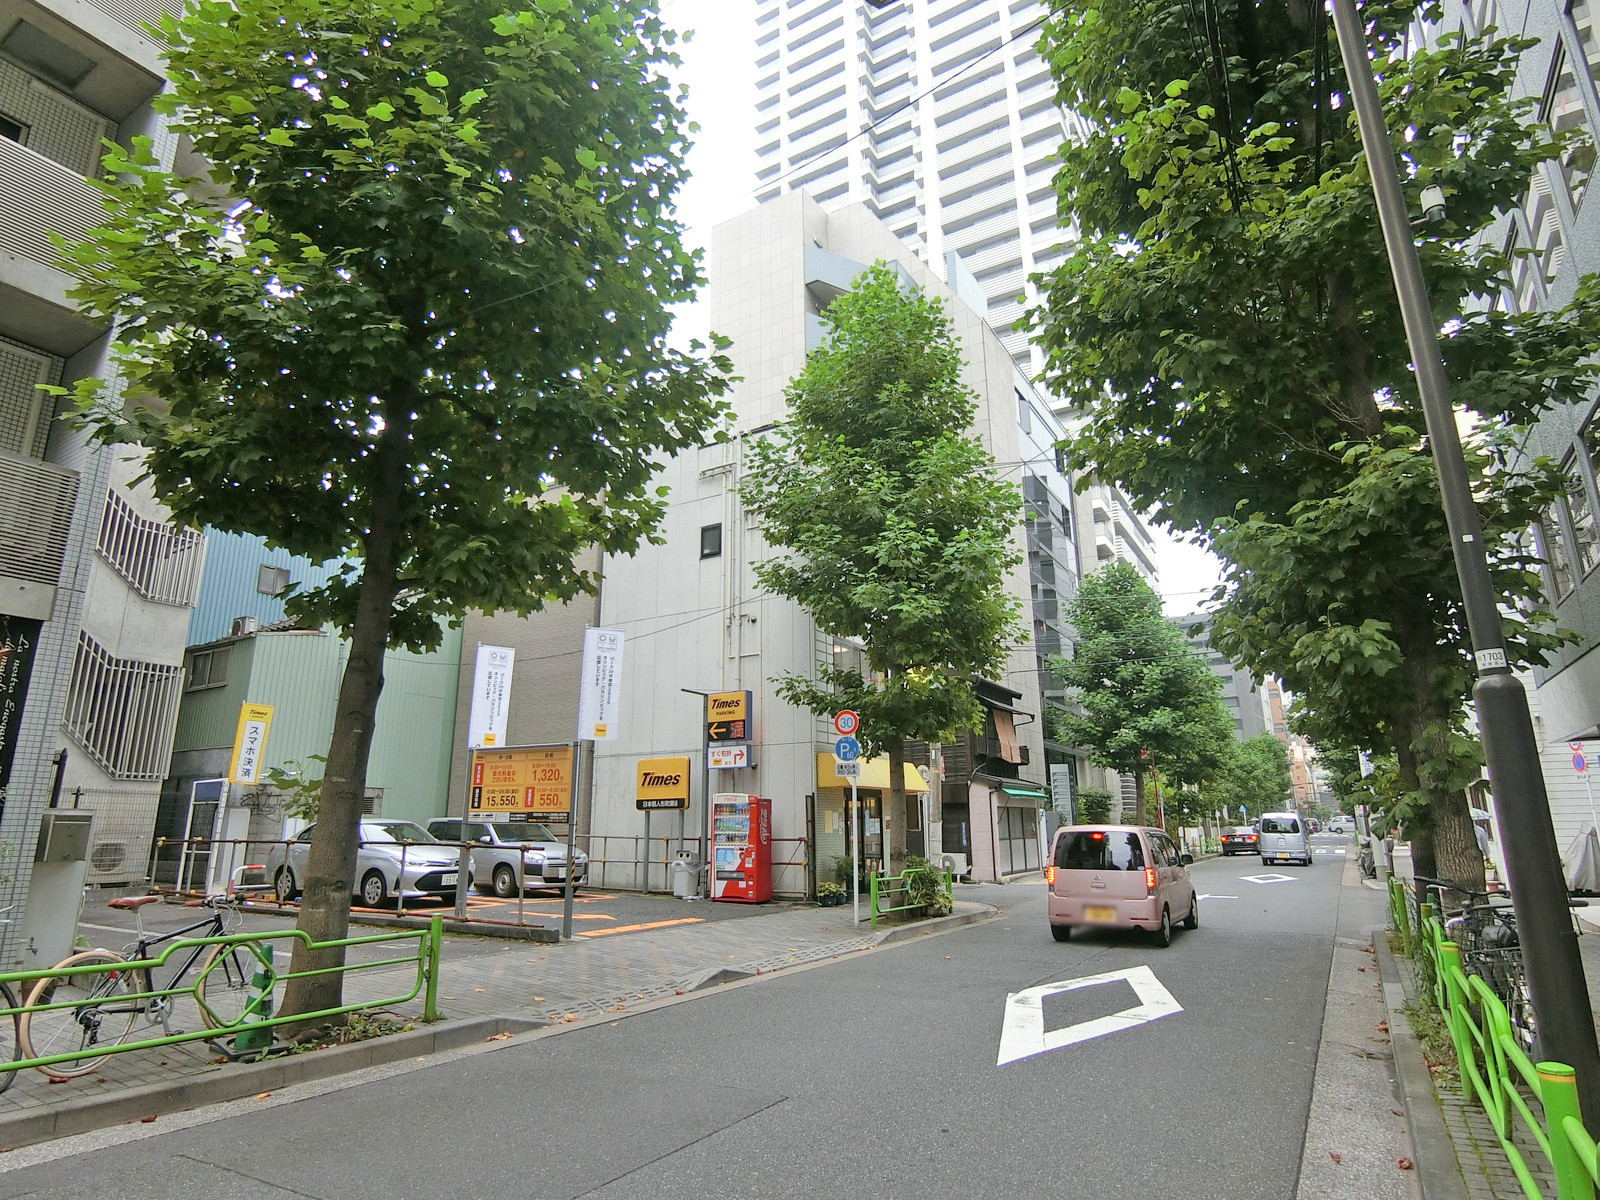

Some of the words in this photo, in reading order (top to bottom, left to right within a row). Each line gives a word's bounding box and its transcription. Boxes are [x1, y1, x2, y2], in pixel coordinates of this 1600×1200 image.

[1482, 652, 1503, 661] 1703
[711, 698, 741, 710] Times
[840, 717, 854, 729] 30
[241, 726, 259, 778] スマホ決済
[641, 772, 682, 787] Times
